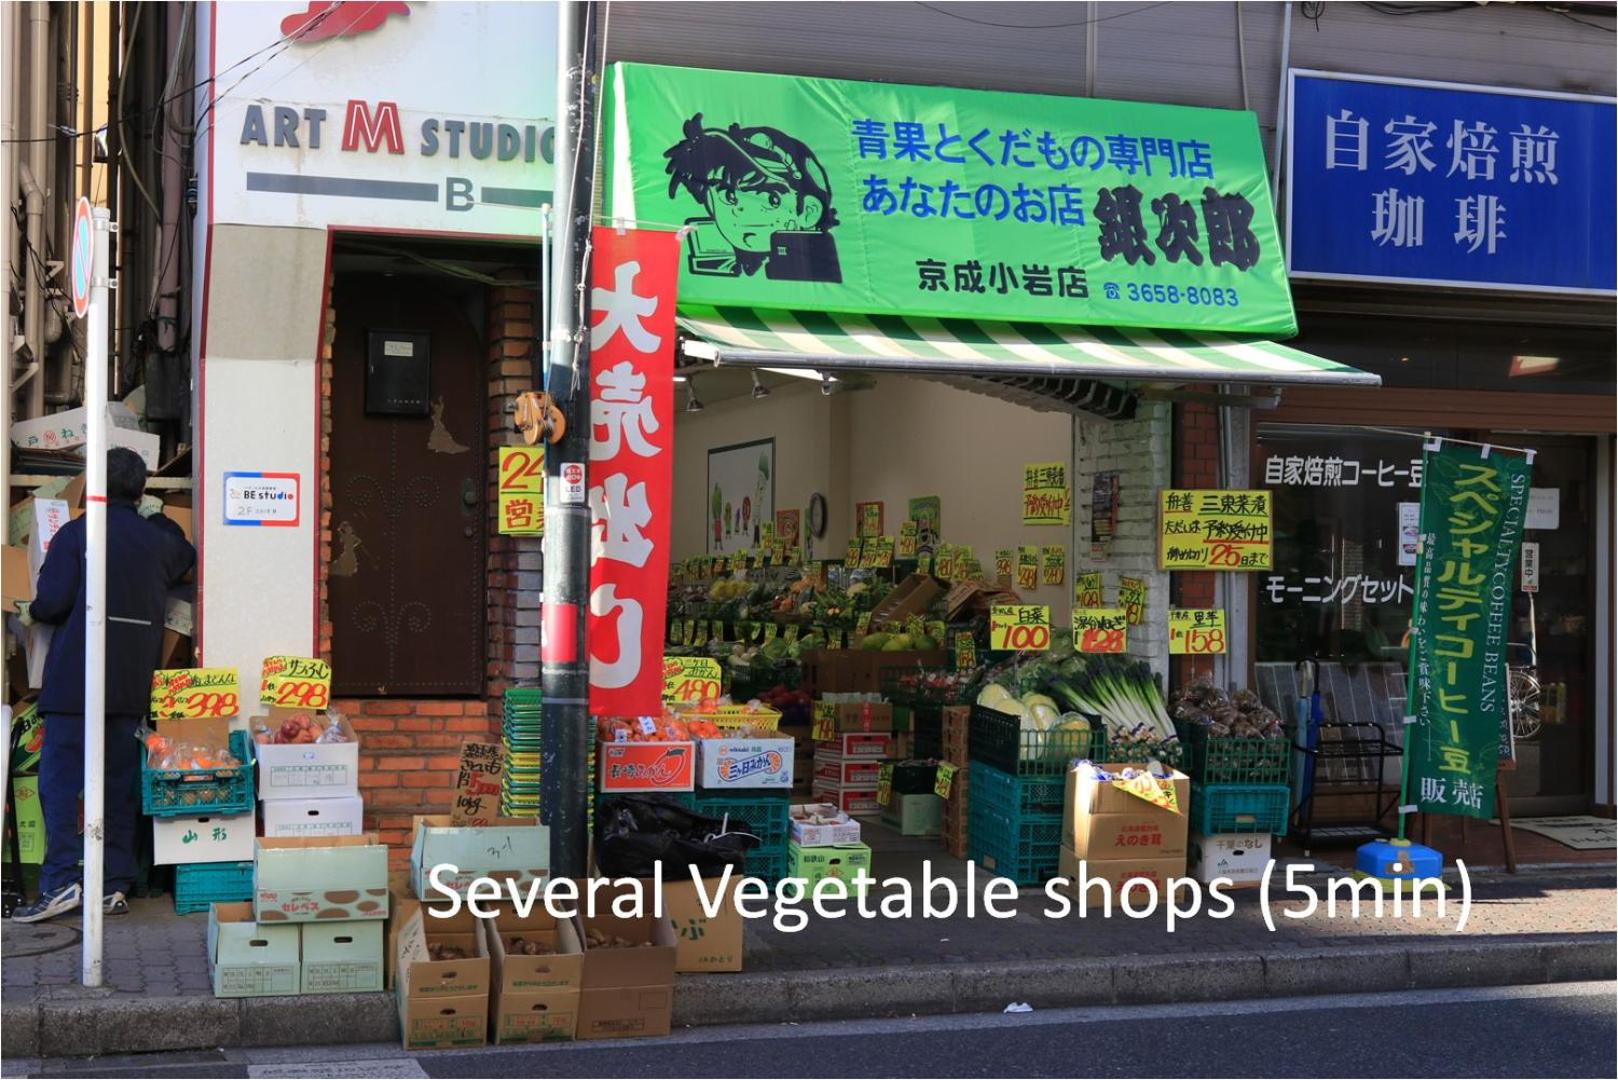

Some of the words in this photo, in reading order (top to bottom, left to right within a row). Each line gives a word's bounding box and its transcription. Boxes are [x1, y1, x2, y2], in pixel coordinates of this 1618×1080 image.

[240, 104, 327, 150] ART
[341, 99, 405, 155] M
[851, 117, 1215, 180] 青果とくだもの専門店
[1325, 108, 1560, 186] 自家焙煎
[444, 177, 475, 213] B
[862, 173, 1085, 226] あなたのお店
[1093, 184, 1260, 272] 銀次郎
[1370, 187, 1508, 255] 珈琲
[915, 257, 1091, 300] 京成小岩店
[1265, 454, 1424, 488] 自家焙煎コーヒー豆
[243, 490, 256, 500] BE
[258, 491, 294, 500] studio
[505, 499, 545, 530] 営
[1265, 573, 1415, 604] モーニングセット
[1016, 606, 1049, 625] 白菜
[1435, 463, 1501, 775] スペシャルティコーヒー豆
[1001, 624, 1049, 649] 100
[1185, 629, 1225, 654] 158
[276, 681, 328, 708] 298
[1479, 651, 1501, 713] BEANS
[182, 826, 228, 844] 山形
[281, 901, 321, 913] セレベス
